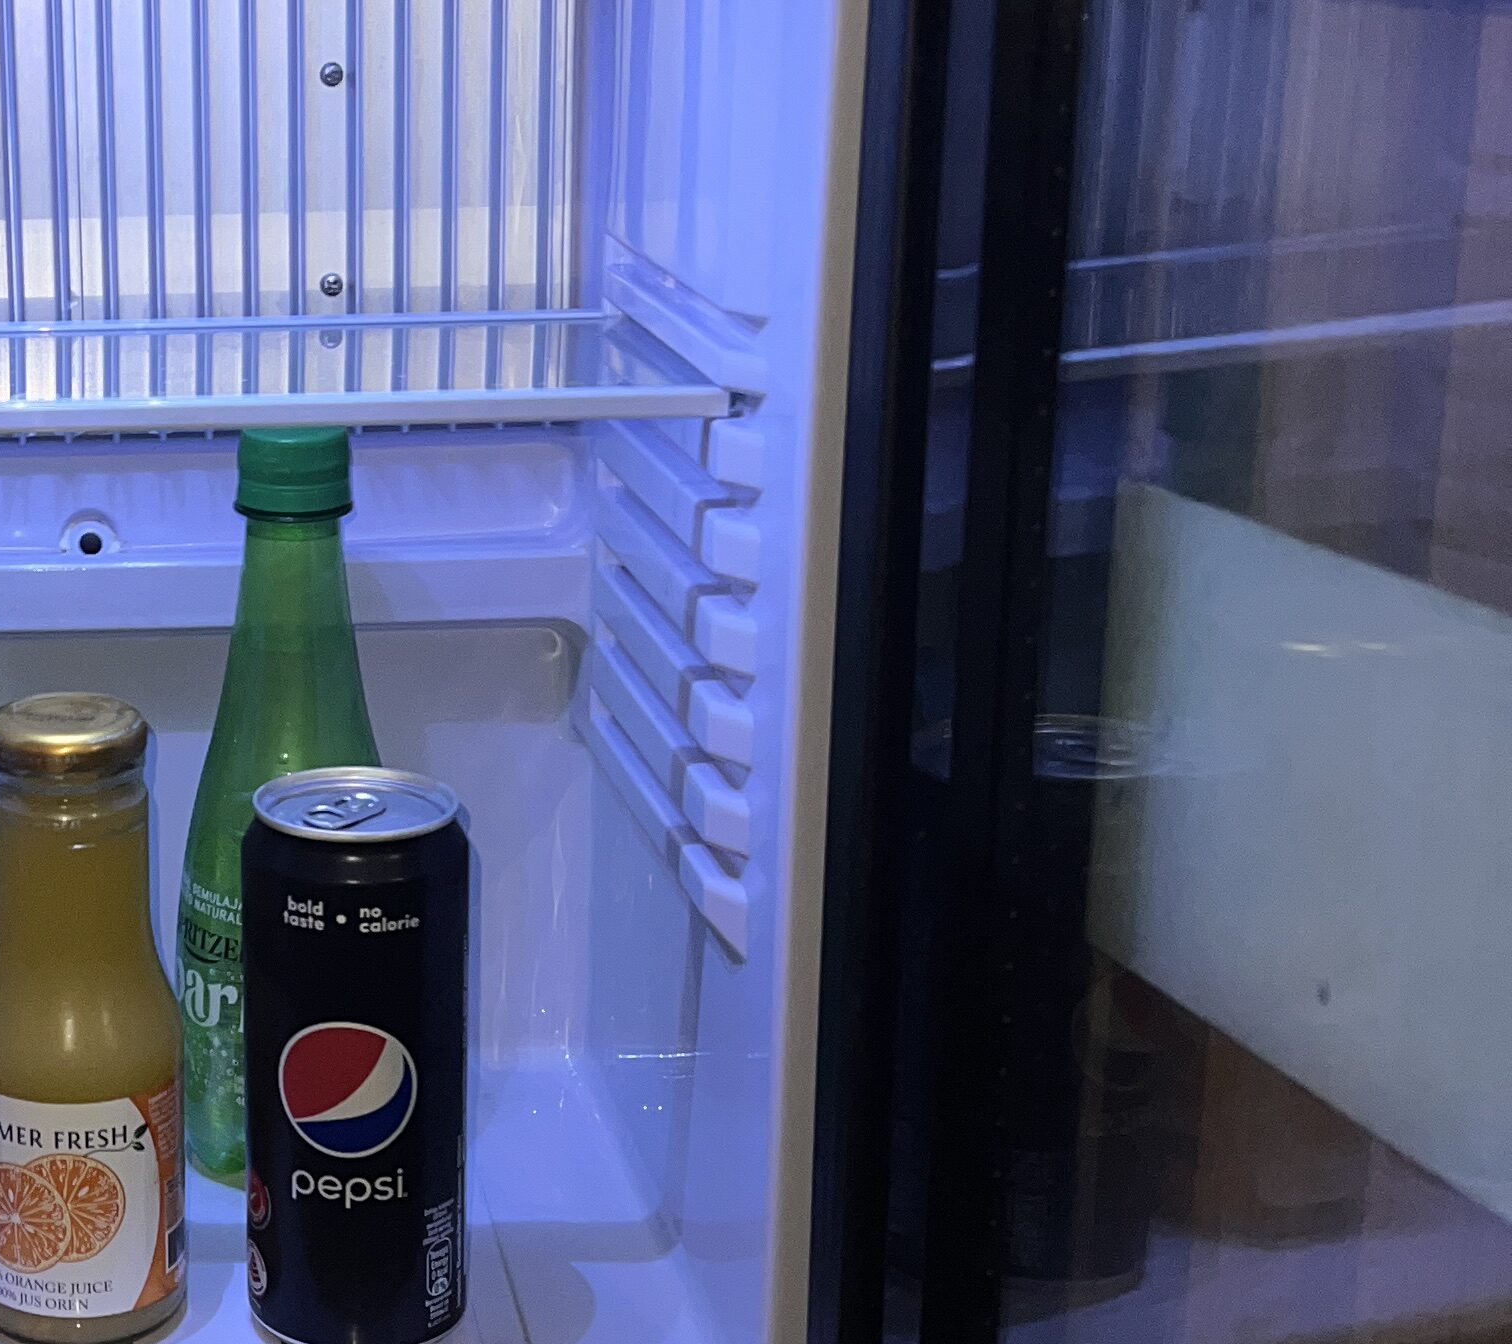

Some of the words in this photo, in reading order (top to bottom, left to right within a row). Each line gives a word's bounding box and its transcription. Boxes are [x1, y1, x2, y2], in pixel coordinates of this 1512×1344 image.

[287, 895, 324, 916] bold
[359, 907, 382, 918] no
[283, 910, 325, 931] taste
[359, 914, 420, 933] calorie
[54, 1125, 128, 1149] FRESH
[291, 1168, 404, 1209] pepsi
[5, 1272, 67, 1294] ORANGE
[69, 1279, 113, 1297] JUICE
[18, 1292, 42, 1308] JUS
[45, 1297, 88, 1311] OREN
